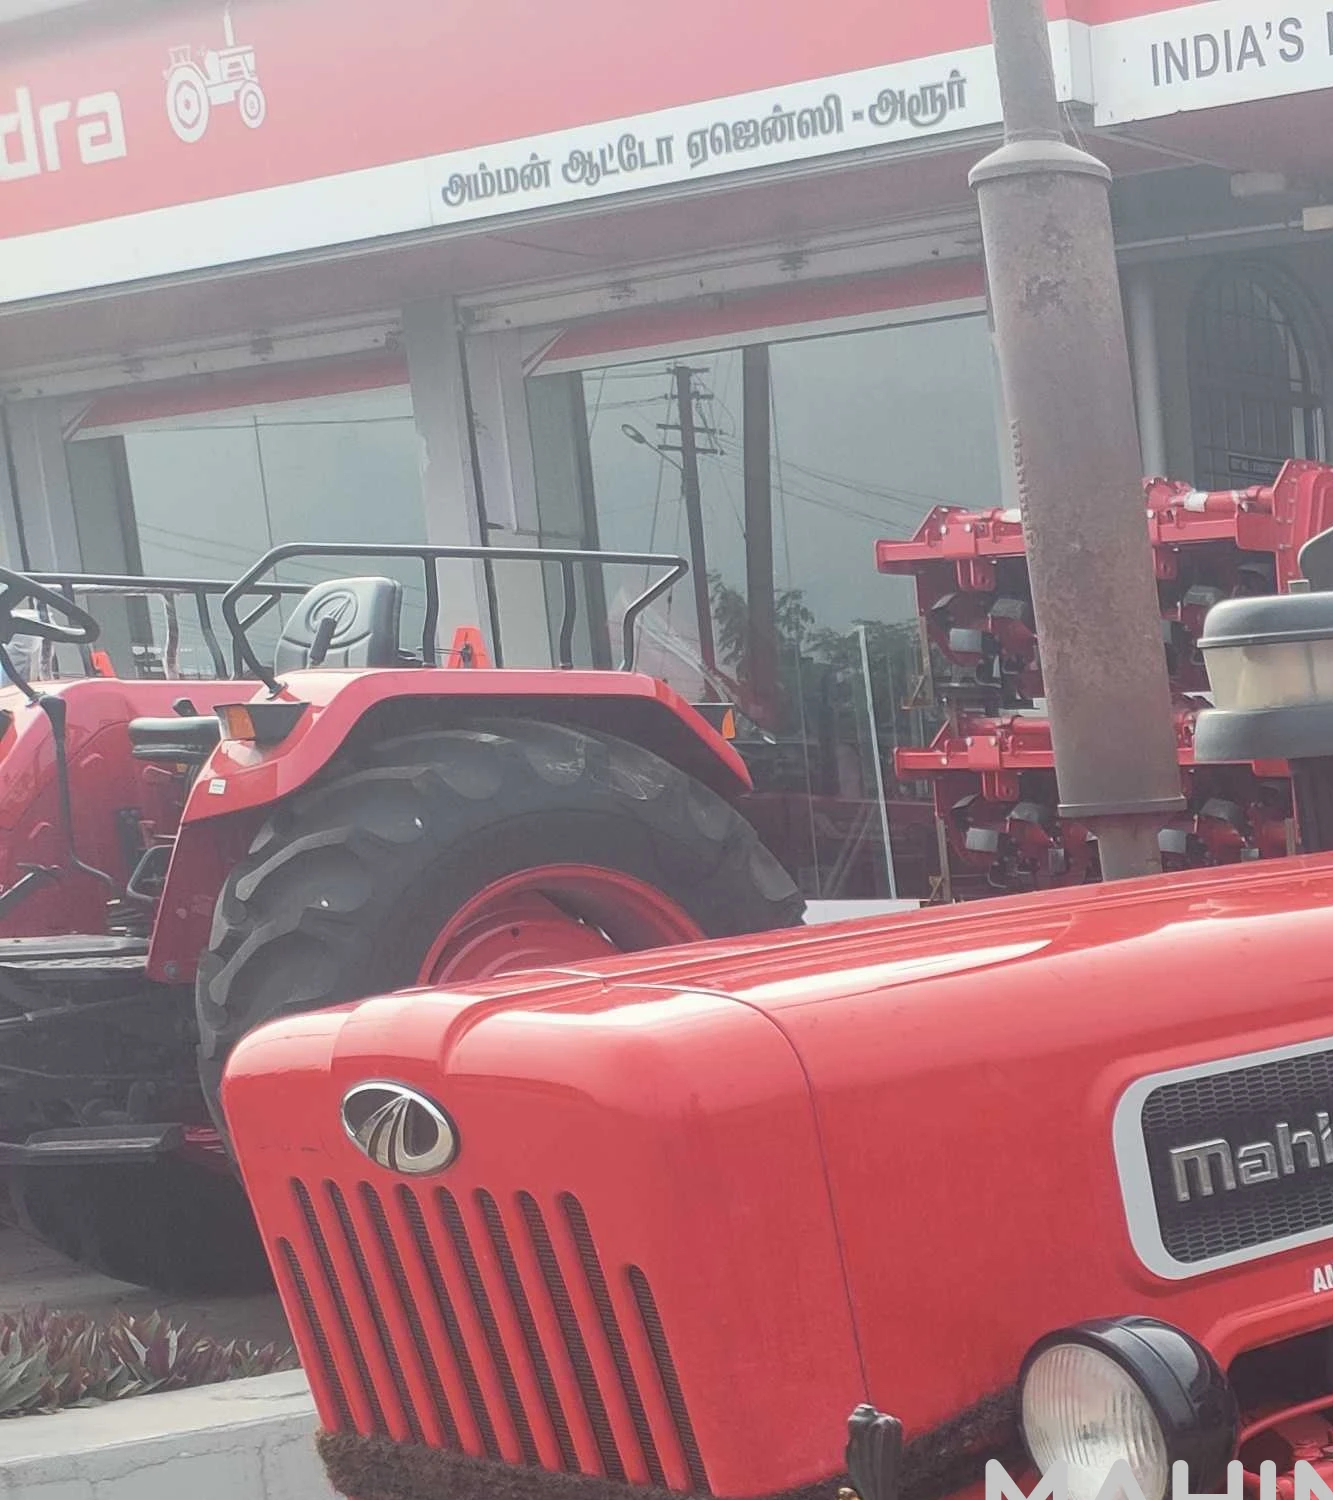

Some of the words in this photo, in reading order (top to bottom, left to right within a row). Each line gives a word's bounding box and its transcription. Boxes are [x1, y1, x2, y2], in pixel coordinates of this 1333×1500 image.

[1151, 16, 1304, 87] INDIA'S
[441, 151, 552, 207] அம்மன்
[562, 133, 674, 188] ஆட்டோ
[686, 93, 844, 170] ஏஜென்ஸி
